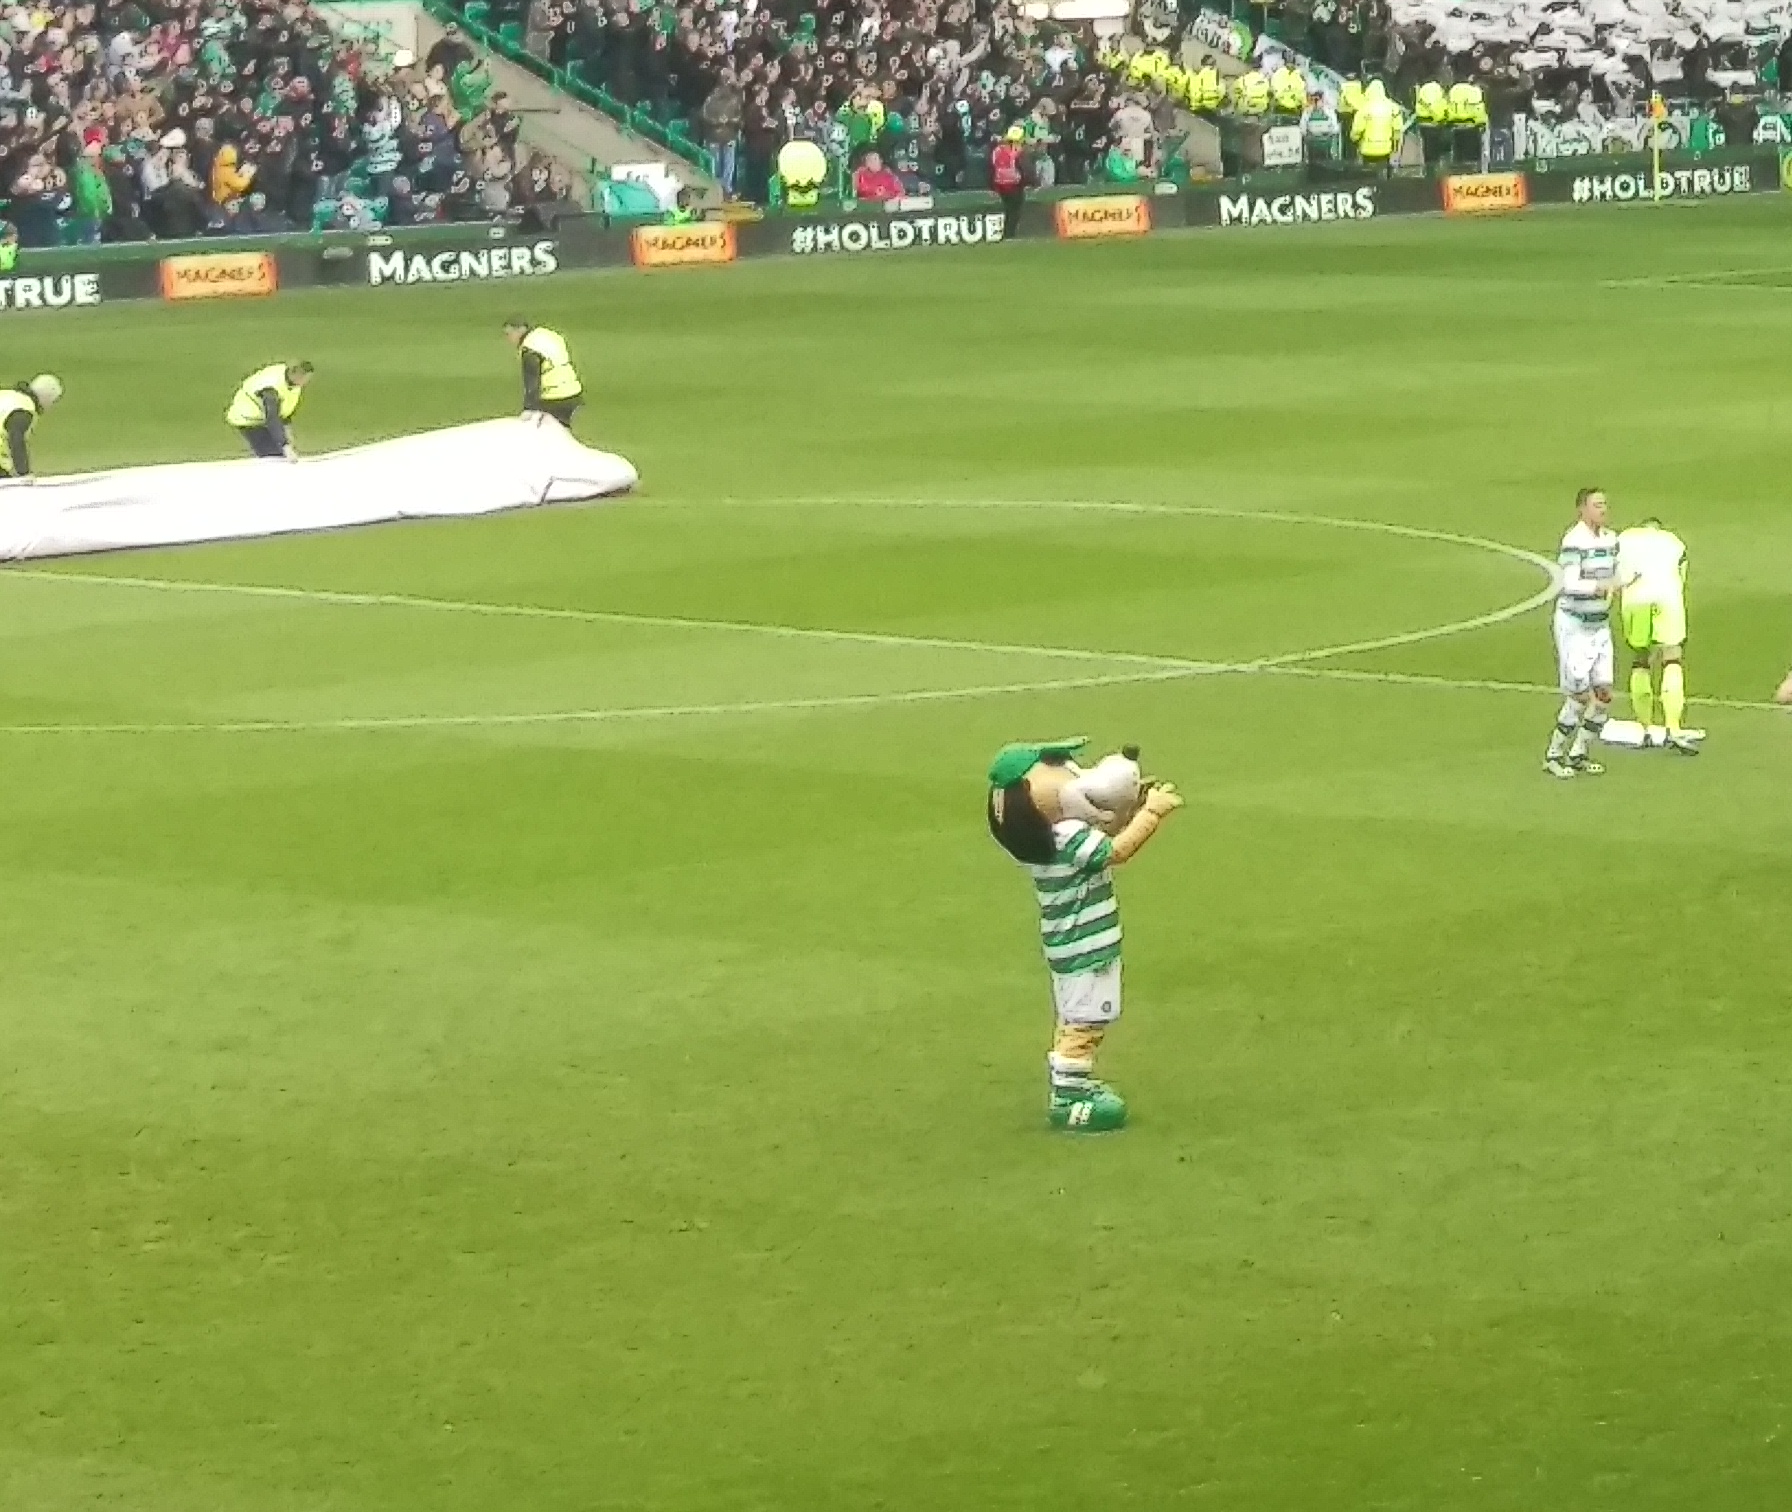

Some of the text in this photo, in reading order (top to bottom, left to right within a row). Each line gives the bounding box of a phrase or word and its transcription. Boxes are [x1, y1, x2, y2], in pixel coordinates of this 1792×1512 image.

[1572, 165, 1750, 203] #HOLDTRUE
[1219, 187, 1375, 230] MAGNERS
[791, 213, 1005, 254] #HOLDTRUE
[173, 262, 268, 286] MAGNERS
[367, 240, 558, 287] MAGNERS
[0, 273, 100, 309] TRUE
